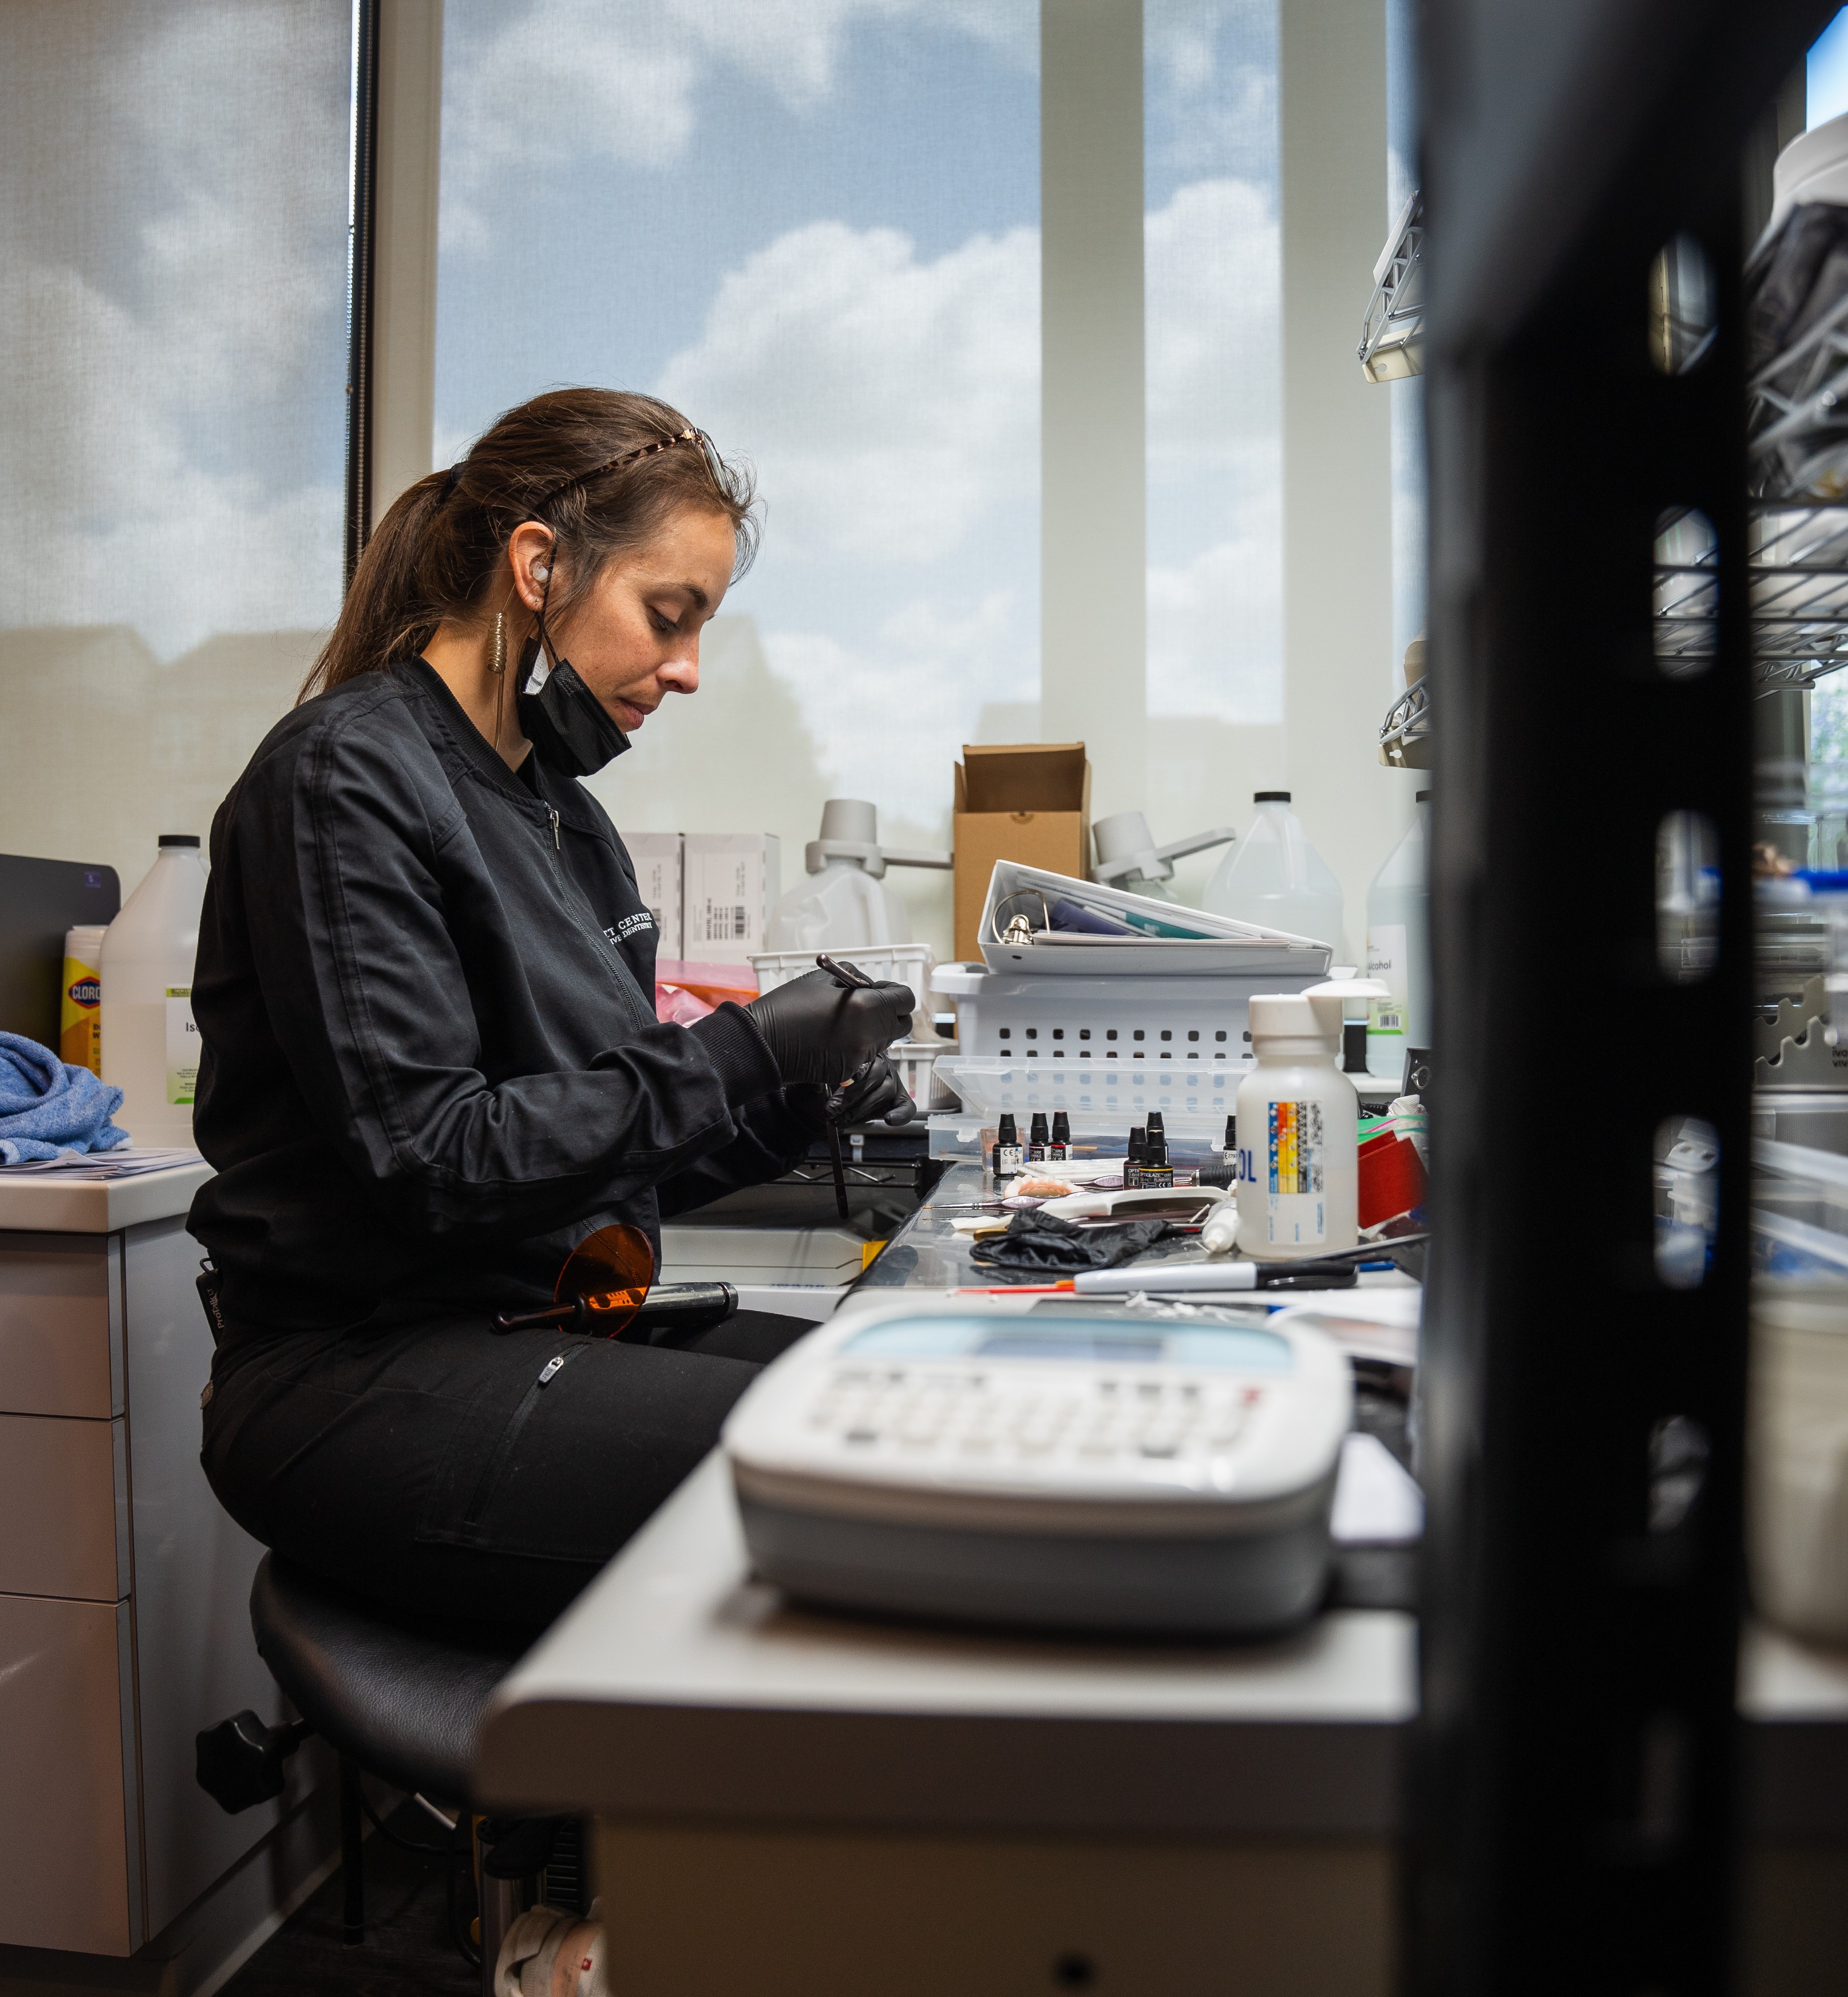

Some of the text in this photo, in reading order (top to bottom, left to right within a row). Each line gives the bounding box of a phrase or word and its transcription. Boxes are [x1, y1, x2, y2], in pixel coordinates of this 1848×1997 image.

[618, 913, 652, 930] CENTER
[622, 922, 653, 938] DENTISTRY
[210, 1291, 225, 1328] ProTalk
